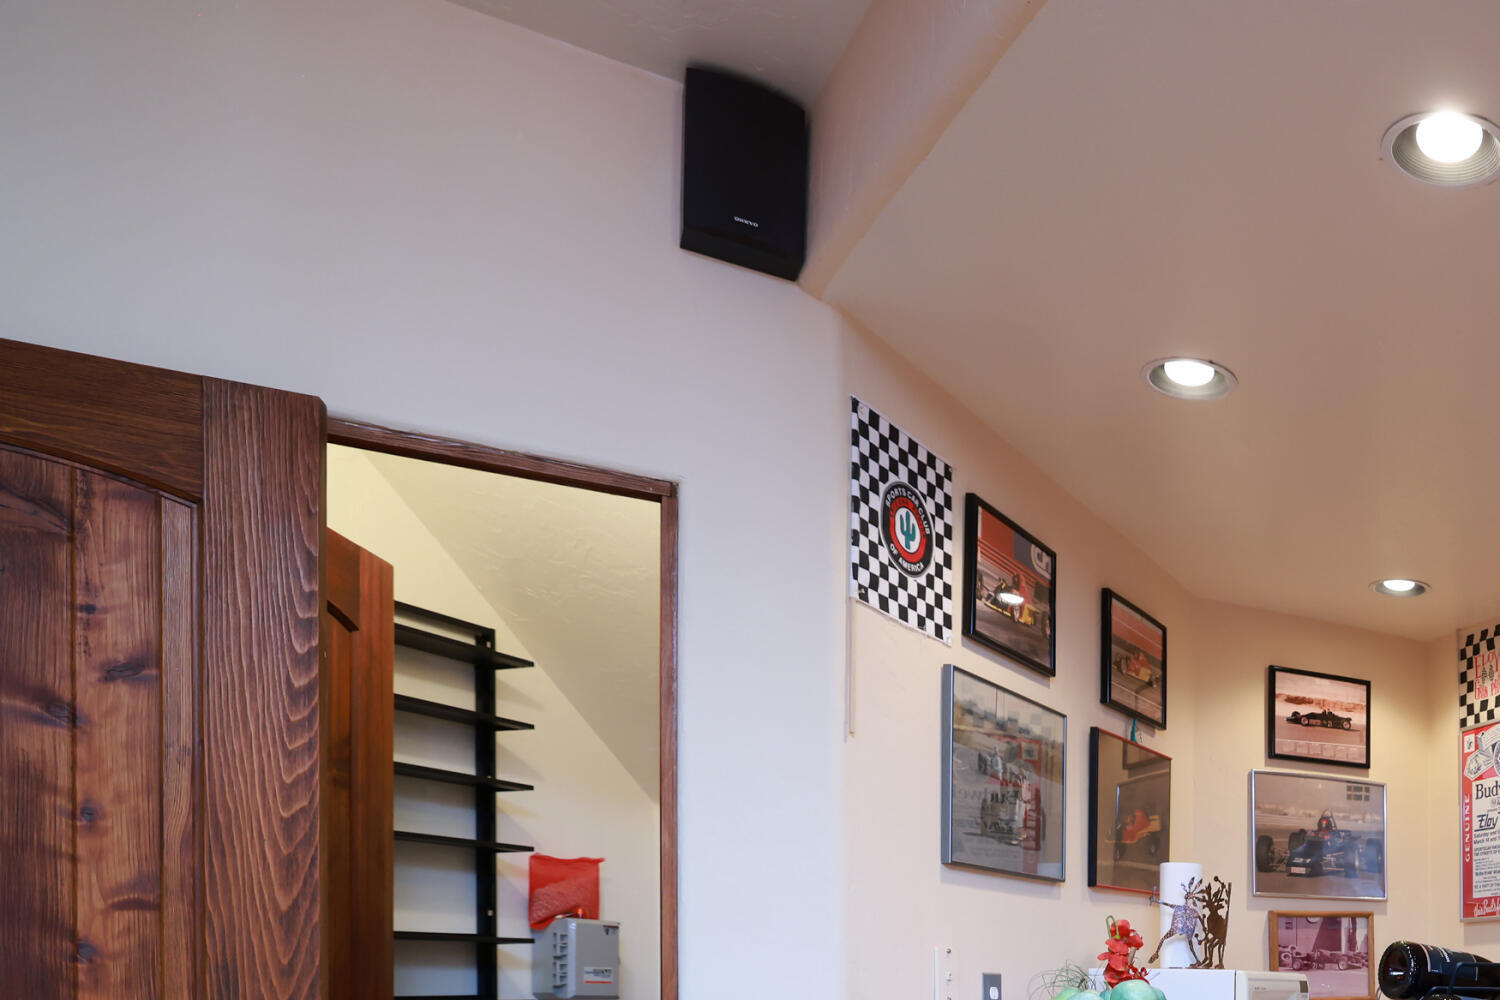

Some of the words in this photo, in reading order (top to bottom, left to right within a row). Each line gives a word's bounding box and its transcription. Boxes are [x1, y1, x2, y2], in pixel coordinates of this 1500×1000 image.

[886, 488, 906, 508] SPORTS
[906, 490, 920, 508] CAR
[918, 508, 930, 534] CLUB
[890, 543, 898, 556] OF
[898, 557, 924, 572] AMERICA
[1477, 814, 1498, 829] Eloy
